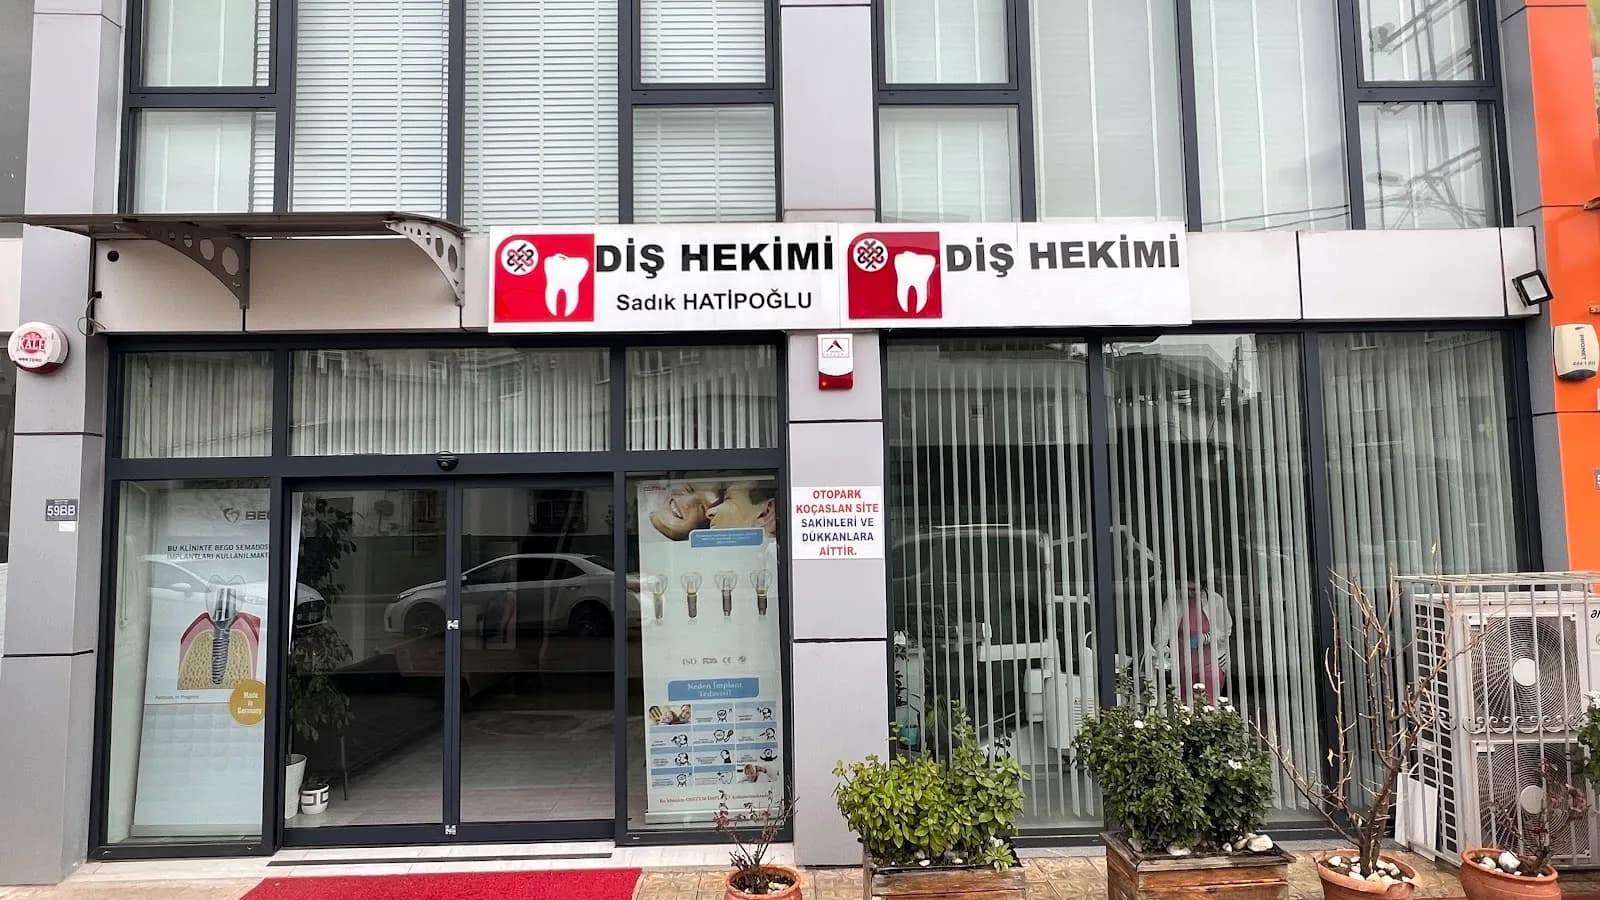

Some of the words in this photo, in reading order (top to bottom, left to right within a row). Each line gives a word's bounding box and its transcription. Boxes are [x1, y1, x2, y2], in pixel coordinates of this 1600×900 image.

[595, 237, 665, 279] DİŞ
[681, 235, 834, 272] HEKİMİ
[946, 236, 1014, 278] DİŞ
[1029, 233, 1180, 270] HEKİMİ
[616, 293, 676, 311] Sadık
[684, 289, 812, 311] HATİPOĞLU
[813, 489, 862, 500] OTOPARK
[796, 503, 853, 516] KOÇASLAN
[856, 501, 879, 513] SİTE
[801, 515, 857, 528] SAKİNLERİ
[860, 517, 874, 527] VE
[802, 530, 874, 542] DÜKKANLARA
[179, 544, 213, 552] KLİNİKTE
[819, 544, 857, 556] AİTTİR.
[243, 691, 259, 699] Made
[237, 706, 262, 715] Germany
